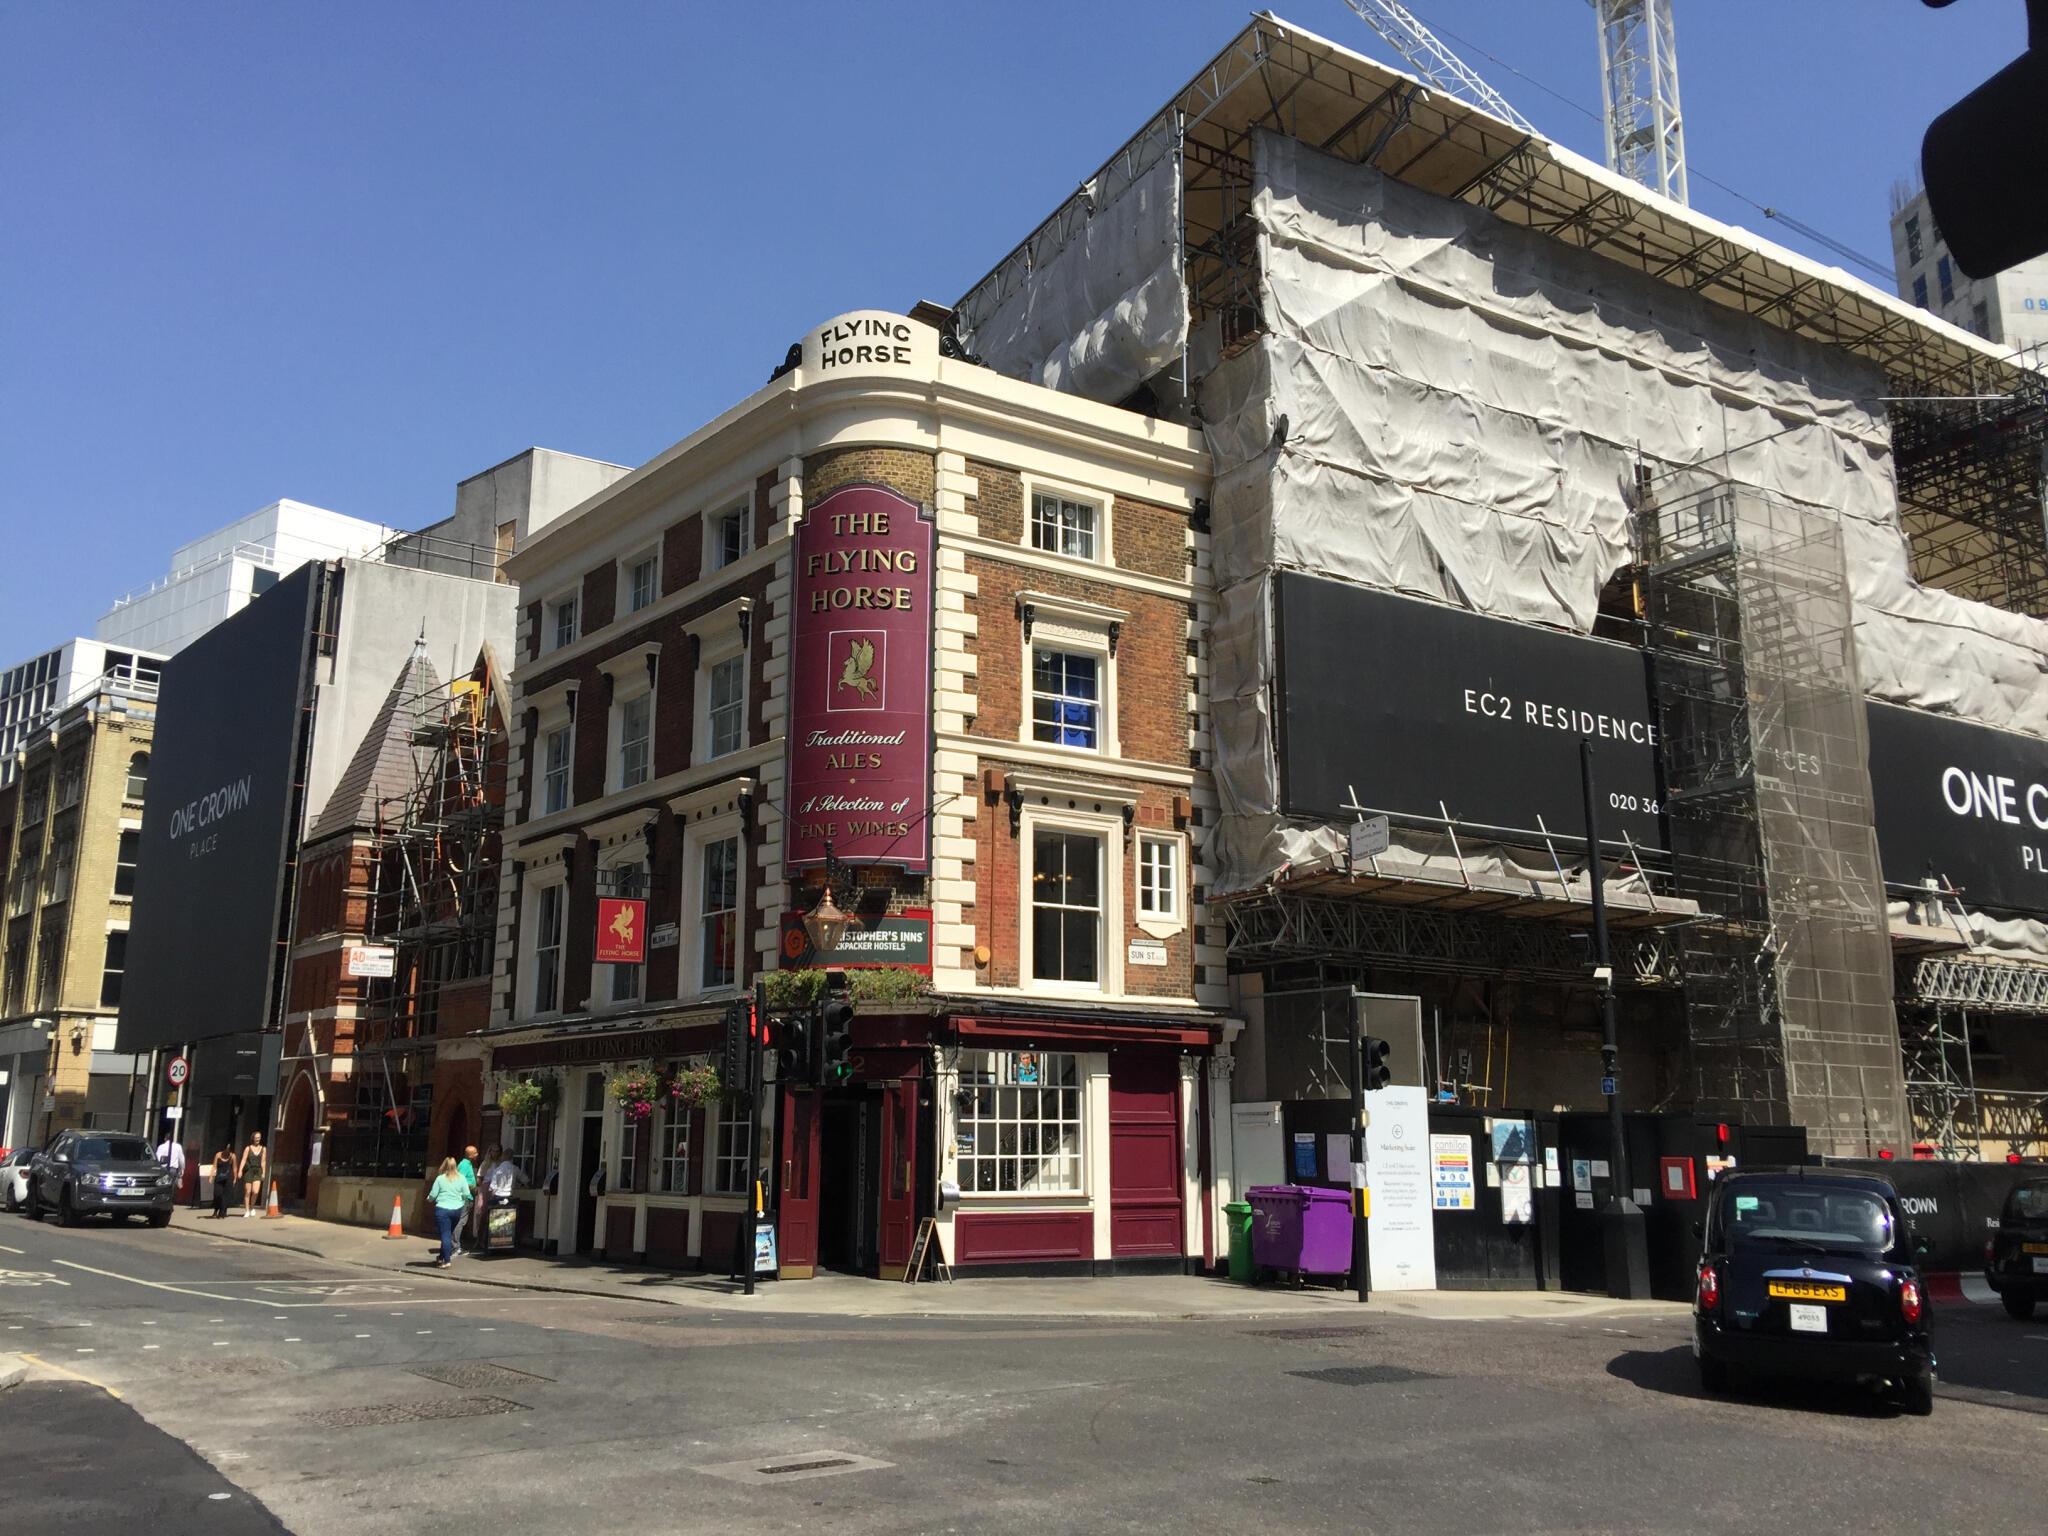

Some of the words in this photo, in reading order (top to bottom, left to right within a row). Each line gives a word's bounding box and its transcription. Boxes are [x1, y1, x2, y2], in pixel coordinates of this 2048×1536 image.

[821, 319, 911, 348] FLYING
[822, 346, 911, 370] HORSE
[830, 512, 890, 536] THE
[807, 549, 917, 577] FLYING
[811, 587, 912, 612] HORSE
[1464, 689, 1512, 720] EC2
[805, 729, 906, 748] Traditional
[825, 752, 882, 770] ALES
[799, 797, 815, 814] A
[816, 794, 885, 813] Selection
[890, 796, 910, 815] of
[1609, 792, 1638, 811] 020
[1942, 766, 2021, 825] ONE
[170, 801, 197, 839] ONE
[198, 774, 252, 827] CROWN
[800, 822, 838, 838] FINE
[847, 821, 909, 837] WINES
[189, 833, 218, 860] PLACE
[900, 931, 923, 942] INNS
[599, 949, 620, 957] FLYING
[621, 949, 640, 957] HORSE
[873, 942, 906, 951] HOSTELS
[1131, 950, 1144, 960] SUN
[351, 951, 366, 963] AD
[587, 1039, 625, 1057] FLYING
[631, 1035, 666, 1054] HORSE
[171, 1065, 186, 1077] 20
[1434, 1139, 1468, 1149] cantillon
[1900, 1197, 1938, 1215] ROWN
[1775, 1282, 1810, 1296] LP65
[1813, 1284, 1839, 1298] EXS
